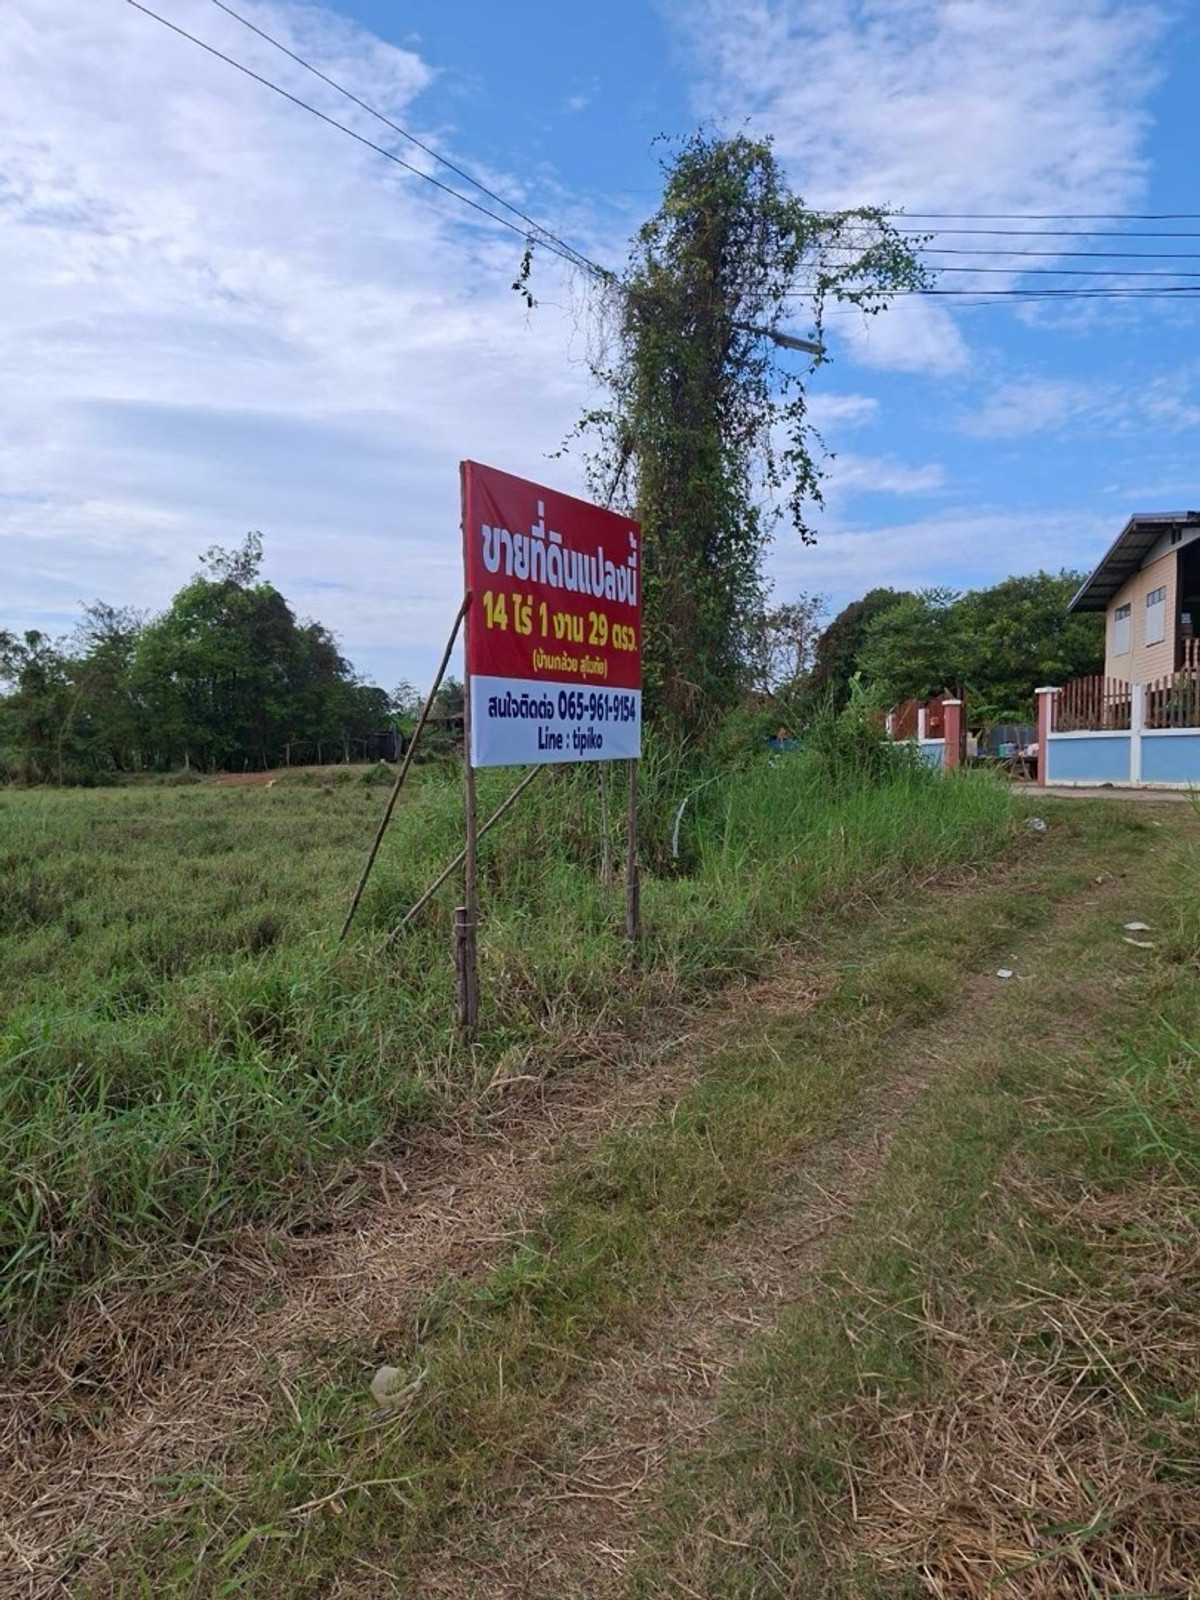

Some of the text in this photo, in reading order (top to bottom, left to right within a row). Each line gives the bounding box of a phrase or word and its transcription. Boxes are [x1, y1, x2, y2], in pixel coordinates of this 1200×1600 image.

[481, 501, 637, 607] ขายที่ดินแปลงนี้
[483, 590, 508, 631] 14
[513, 594, 533, 636] ไร่
[539, 601, 548, 638] 1
[553, 613, 584, 643] งาน
[588, 612, 608, 646] 29
[488, 691, 636, 722] สนใจติดต่อ 065-961-9154
[538, 727, 563, 749] Line
[572, 726, 603, 756] tipiko
